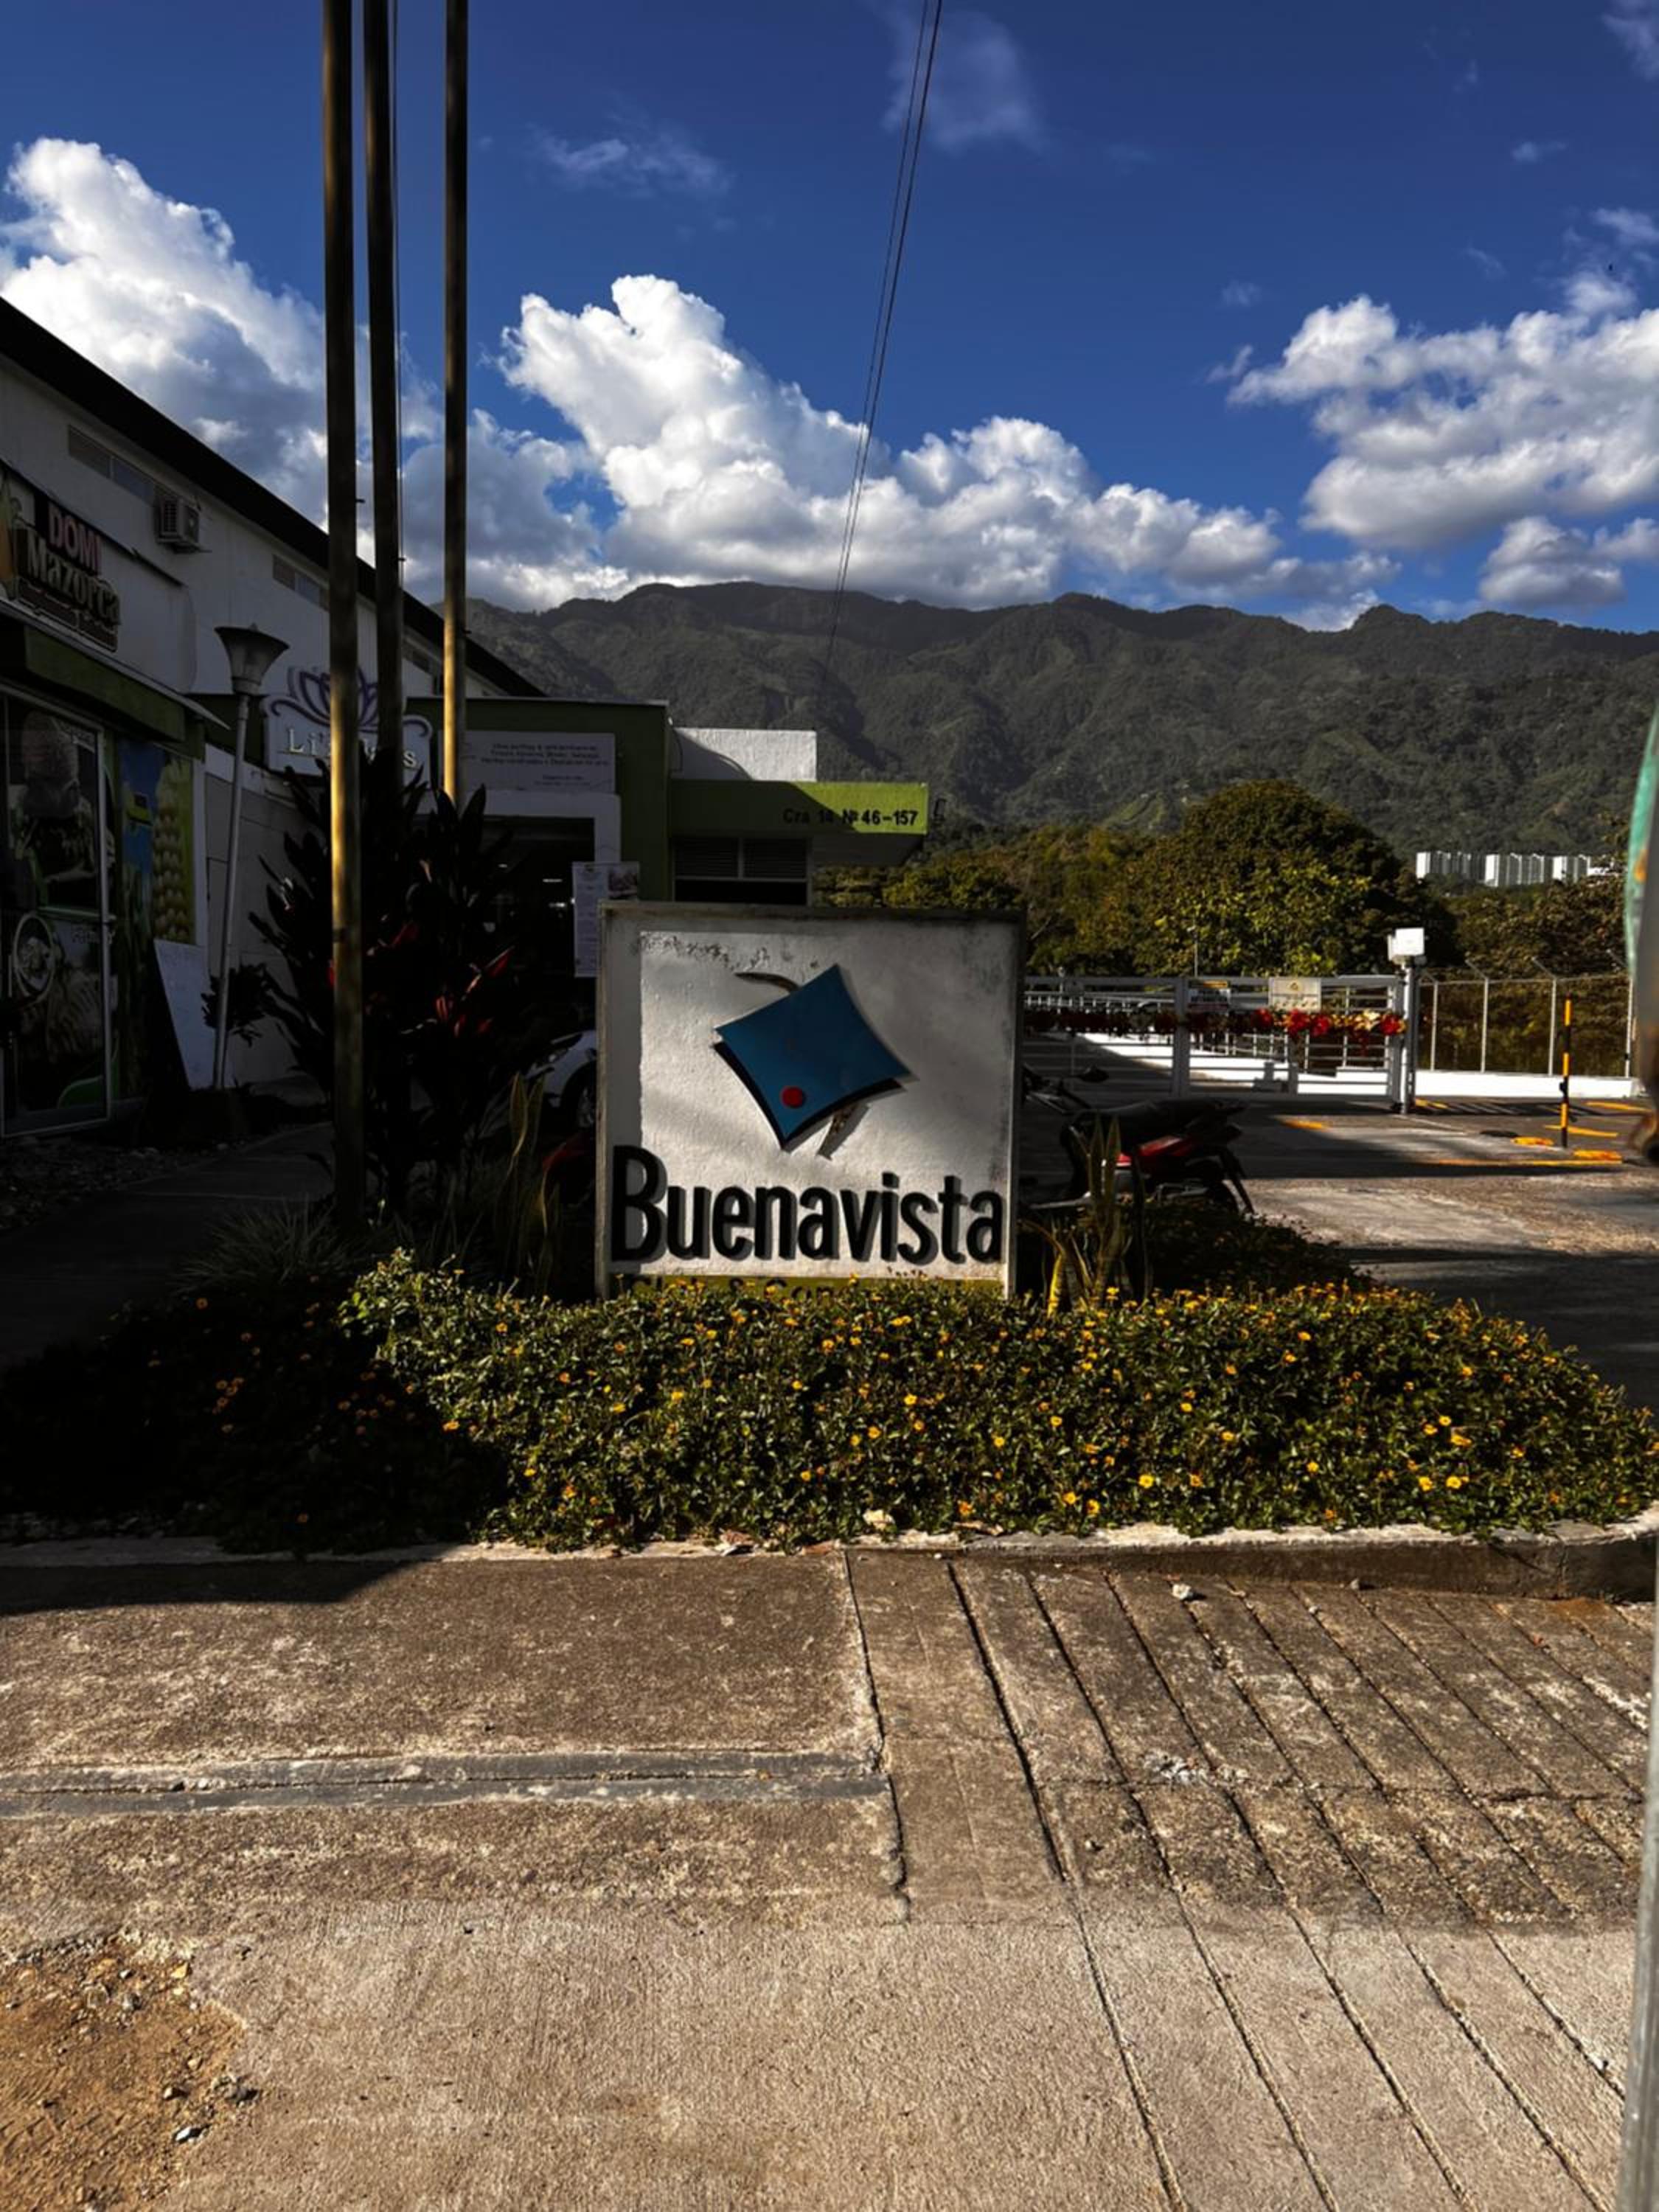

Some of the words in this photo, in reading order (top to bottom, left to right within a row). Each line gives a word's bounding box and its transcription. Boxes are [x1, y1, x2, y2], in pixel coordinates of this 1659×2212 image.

[27, 532, 119, 625] Mazorca
[47, 503, 102, 574] DOMI
[782, 808, 810, 824] Cra
[611, 1145, 1004, 1263] Buenavista
